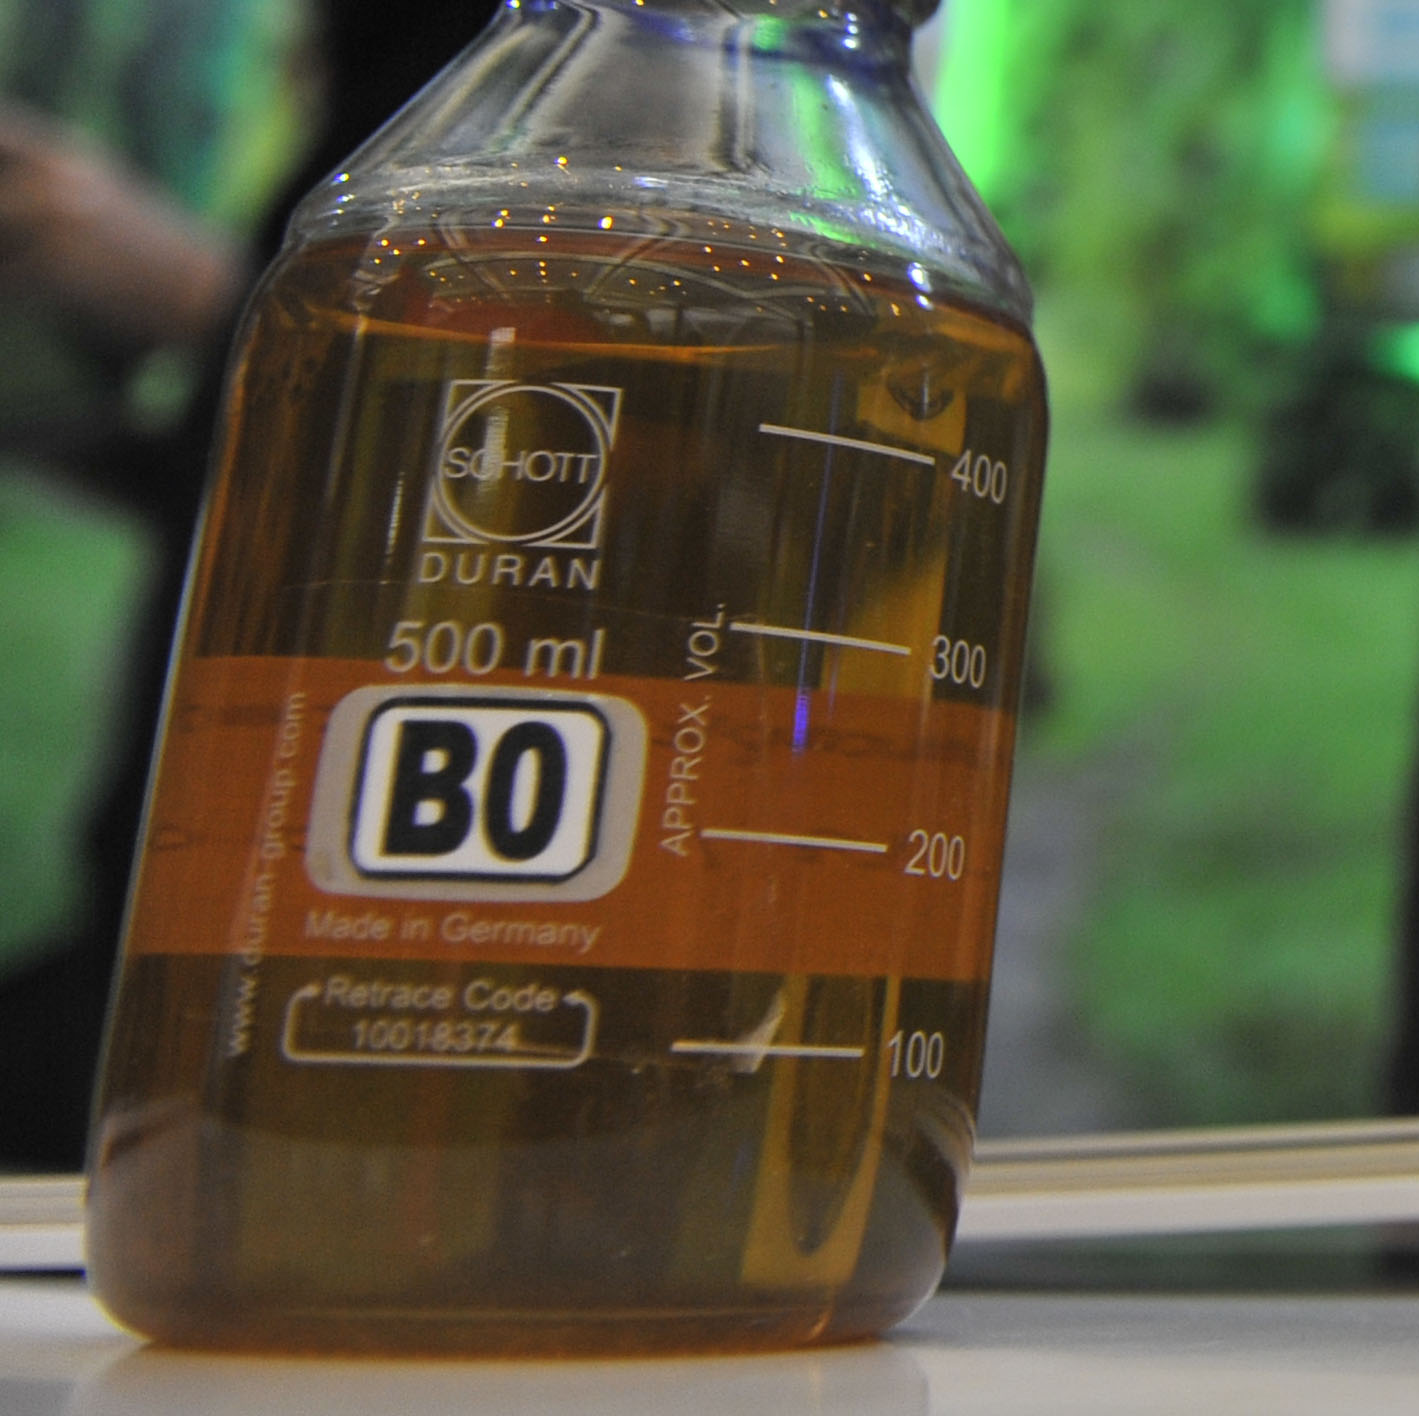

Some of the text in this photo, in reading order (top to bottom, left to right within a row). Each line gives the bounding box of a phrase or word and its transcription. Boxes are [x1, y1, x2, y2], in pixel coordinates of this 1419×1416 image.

[443, 447, 599, 484] SCHOTT
[951, 448, 1007, 504] 400
[418, 551, 600, 590] DURAN
[384, 620, 605, 679] 500 ml
[929, 634, 986, 689] 300
[659, 603, 726, 856] APPROX. VOL.
[904, 829, 965, 880] 200
[304, 911, 602, 955] Made in Germany
[323, 975, 558, 1012] Retrace Code
[353, 1018, 519, 1052] 10018374
[887, 1030, 944, 1079] 100
